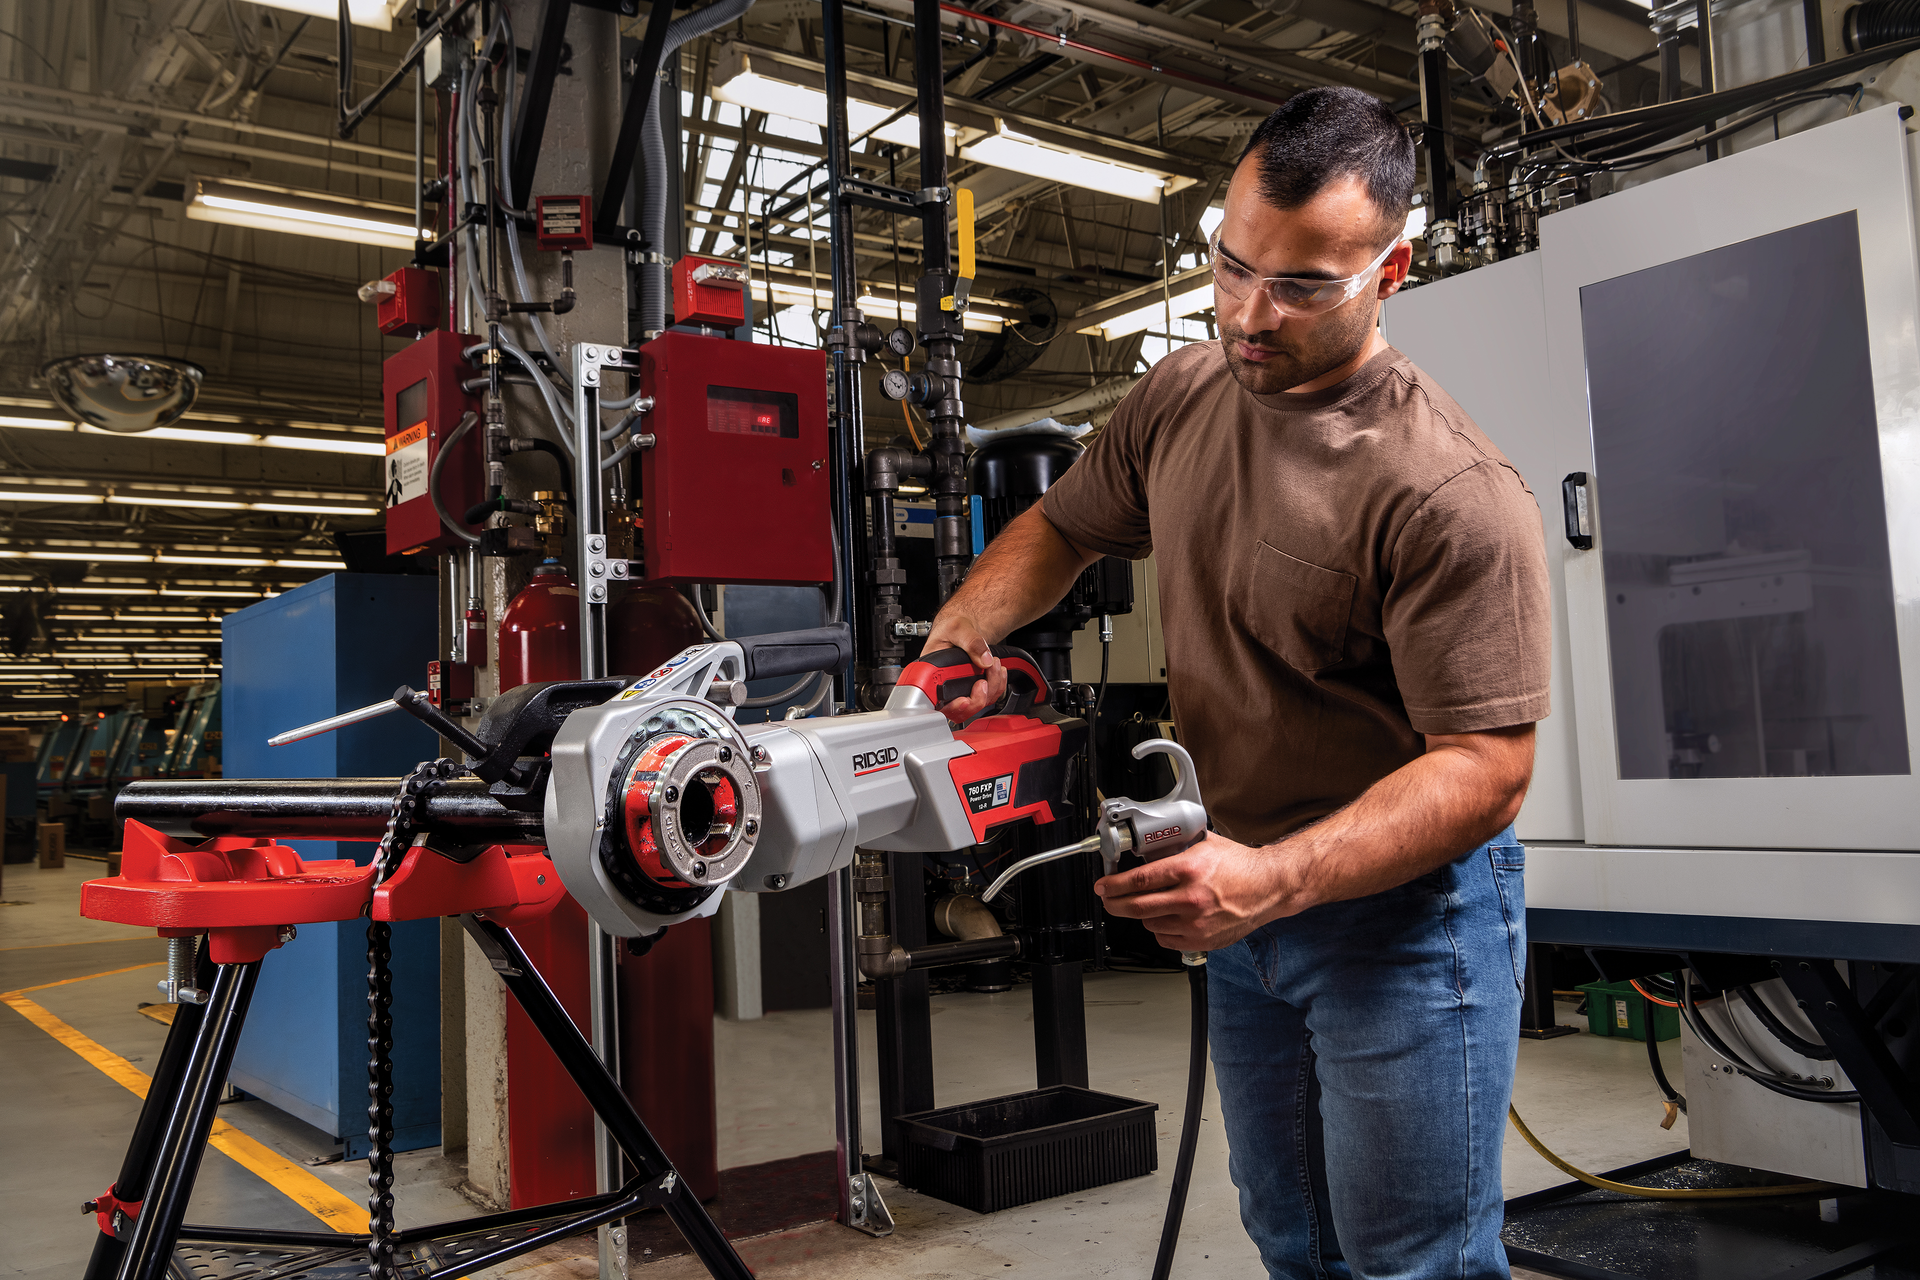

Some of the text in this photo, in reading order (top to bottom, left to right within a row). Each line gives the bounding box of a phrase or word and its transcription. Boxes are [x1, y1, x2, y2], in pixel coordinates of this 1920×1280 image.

[398, 427, 421, 446] WARNING
[852, 746, 899, 771] RIDGID
[968, 782, 993, 796] 760 FXP
[969, 795, 981, 803] Power
[982, 792, 992, 800] Drive
[665, 814, 685, 861] RIDGID
[1144, 825, 1181, 843] RIDGID
